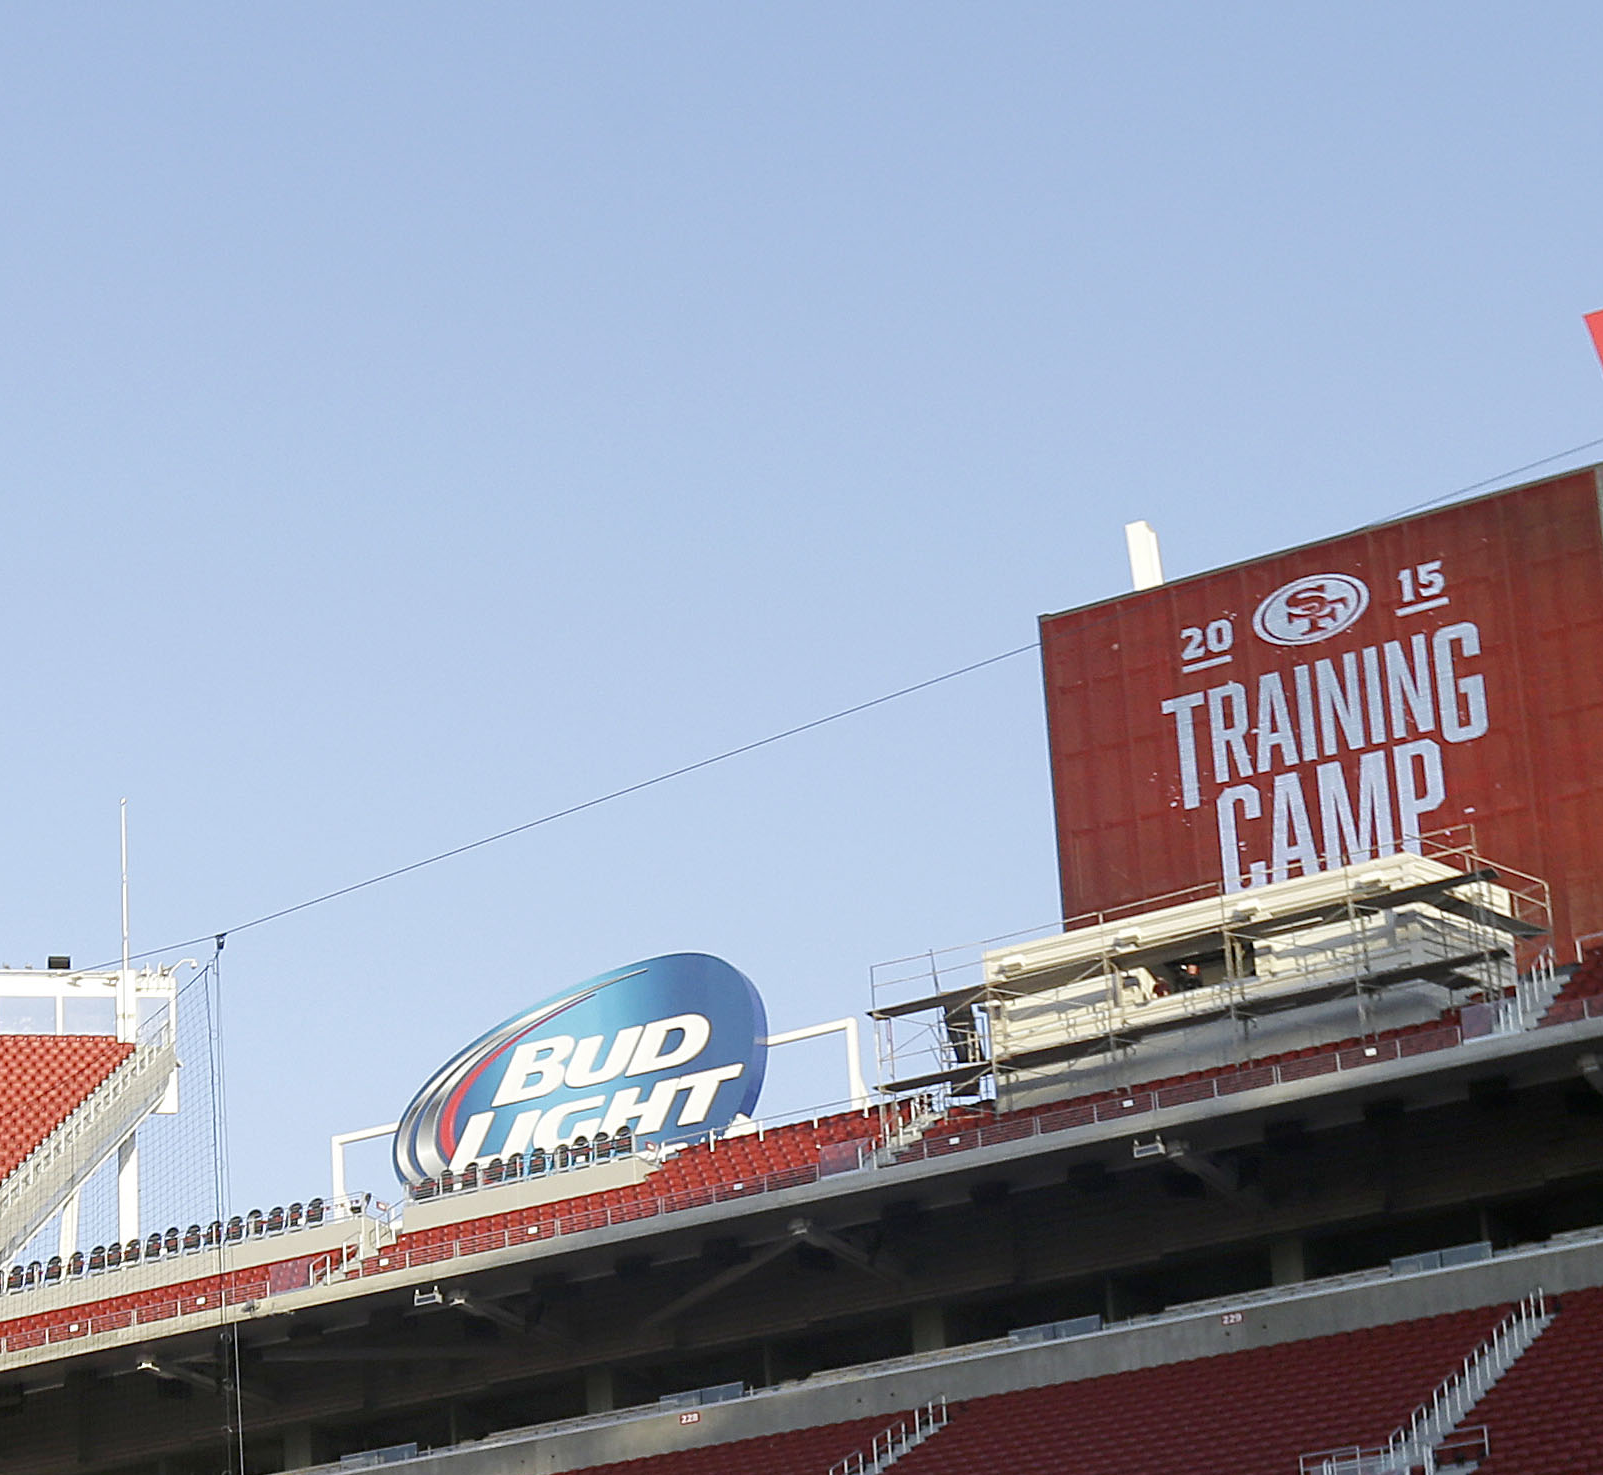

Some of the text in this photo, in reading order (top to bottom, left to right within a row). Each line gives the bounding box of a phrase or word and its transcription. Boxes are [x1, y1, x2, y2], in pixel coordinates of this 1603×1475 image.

[1179, 618, 1234, 661] 20
[1396, 560, 1445, 606] 15
[1162, 621, 1489, 810] TRAINING
[1216, 739, 1446, 895] CAMP
[491, 1013, 711, 1107] BUD
[448, 1063, 745, 1172] LIGHT
